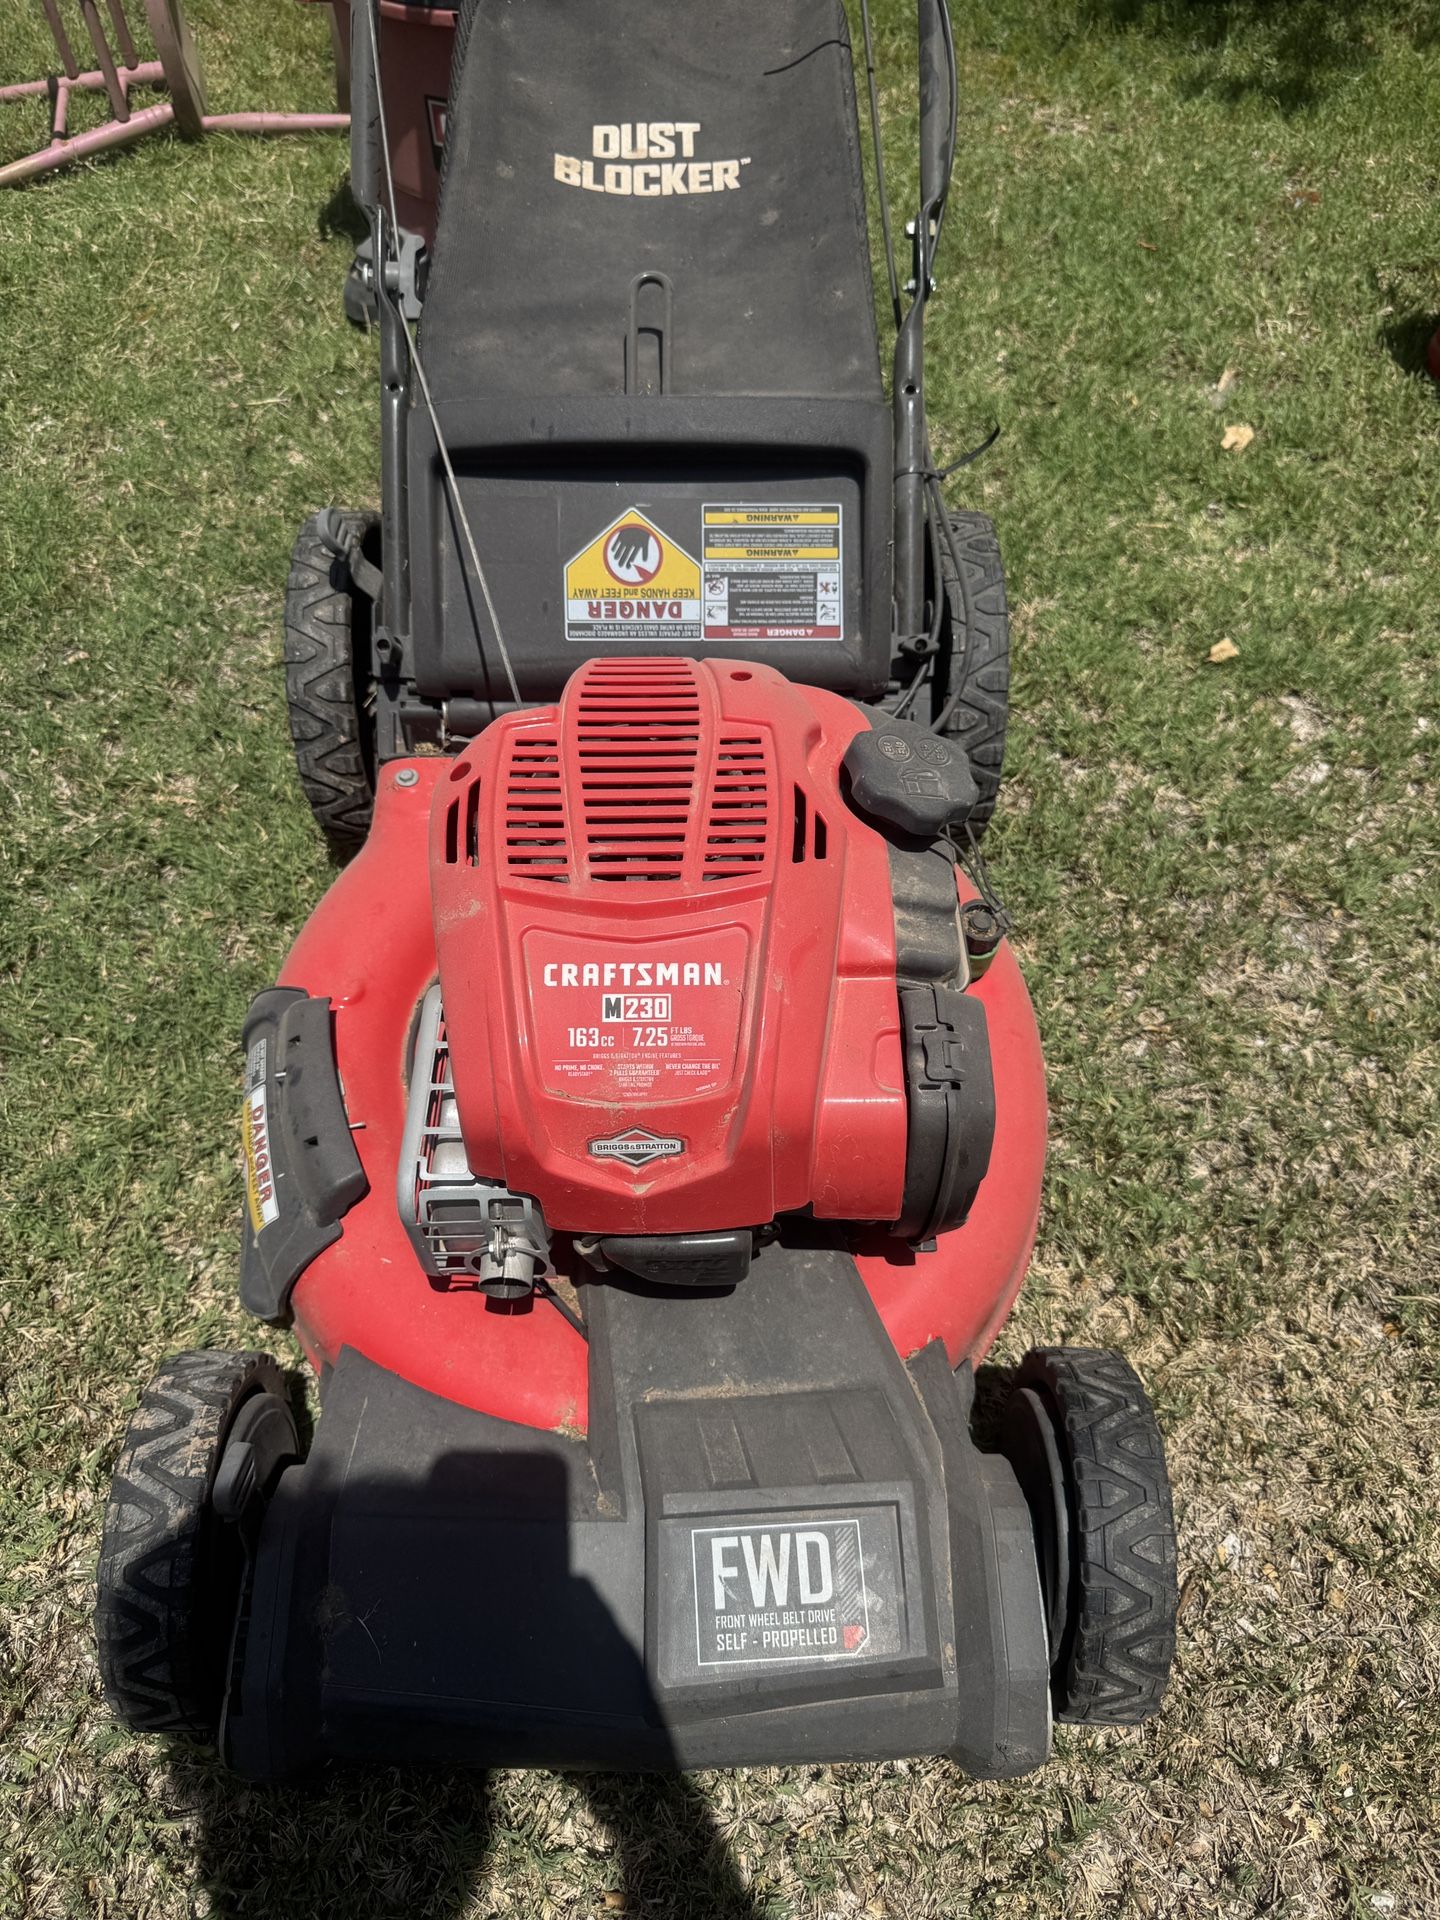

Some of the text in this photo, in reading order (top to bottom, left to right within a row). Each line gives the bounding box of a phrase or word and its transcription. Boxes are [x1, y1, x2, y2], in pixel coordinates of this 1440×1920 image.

[593, 123, 700, 159] DUST
[573, 588, 694, 598] KEEP HANDS and FEET AWAY
[588, 602, 682, 619] DANGER
[633, 1027, 668, 1047] 7.25
[252, 1104, 272, 1204] DANGER
[711, 1531, 833, 1610] FWD
[715, 1609, 836, 1629] FRONT WHEEL BELT DRIVE
[717, 1632, 747, 1651] SELF
[763, 1626, 838, 1649] PROPELLED
